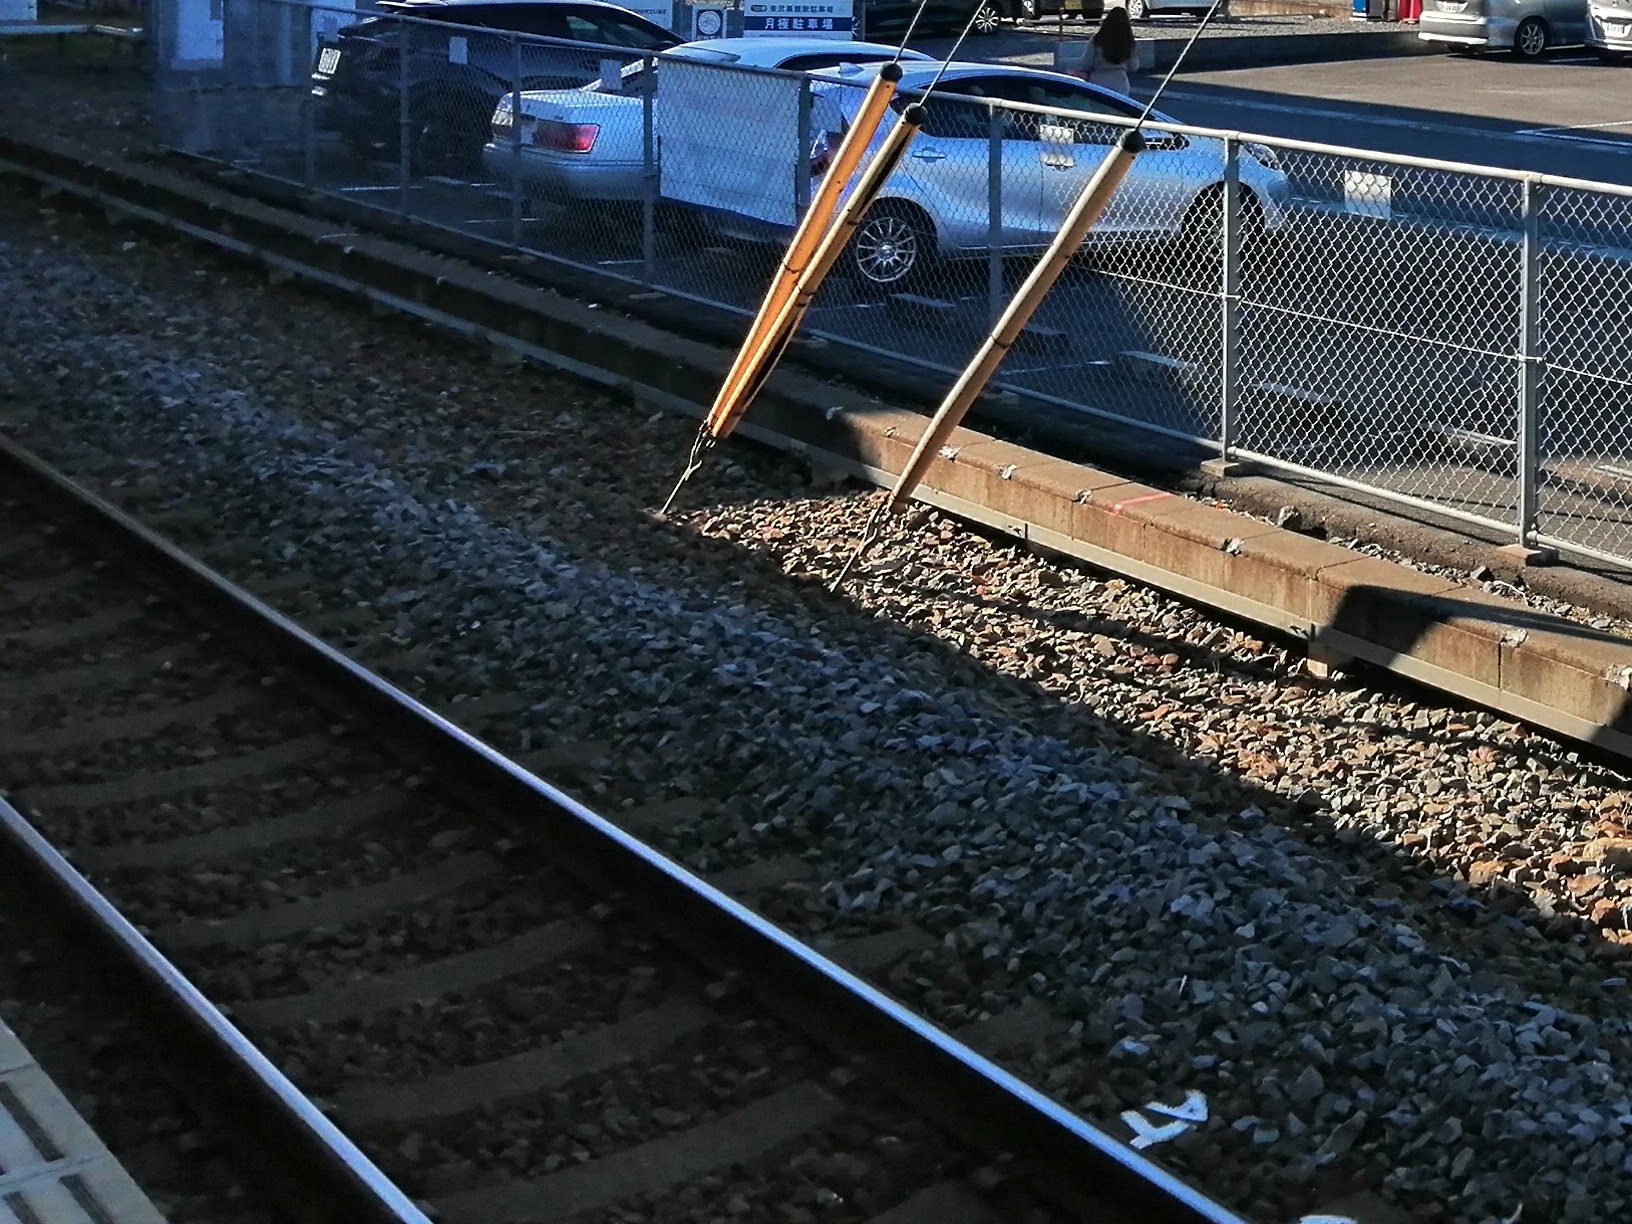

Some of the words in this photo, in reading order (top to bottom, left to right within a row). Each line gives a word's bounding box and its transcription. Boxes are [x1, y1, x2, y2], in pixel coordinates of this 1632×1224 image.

[764, 17, 834, 30] 月極駐車場
